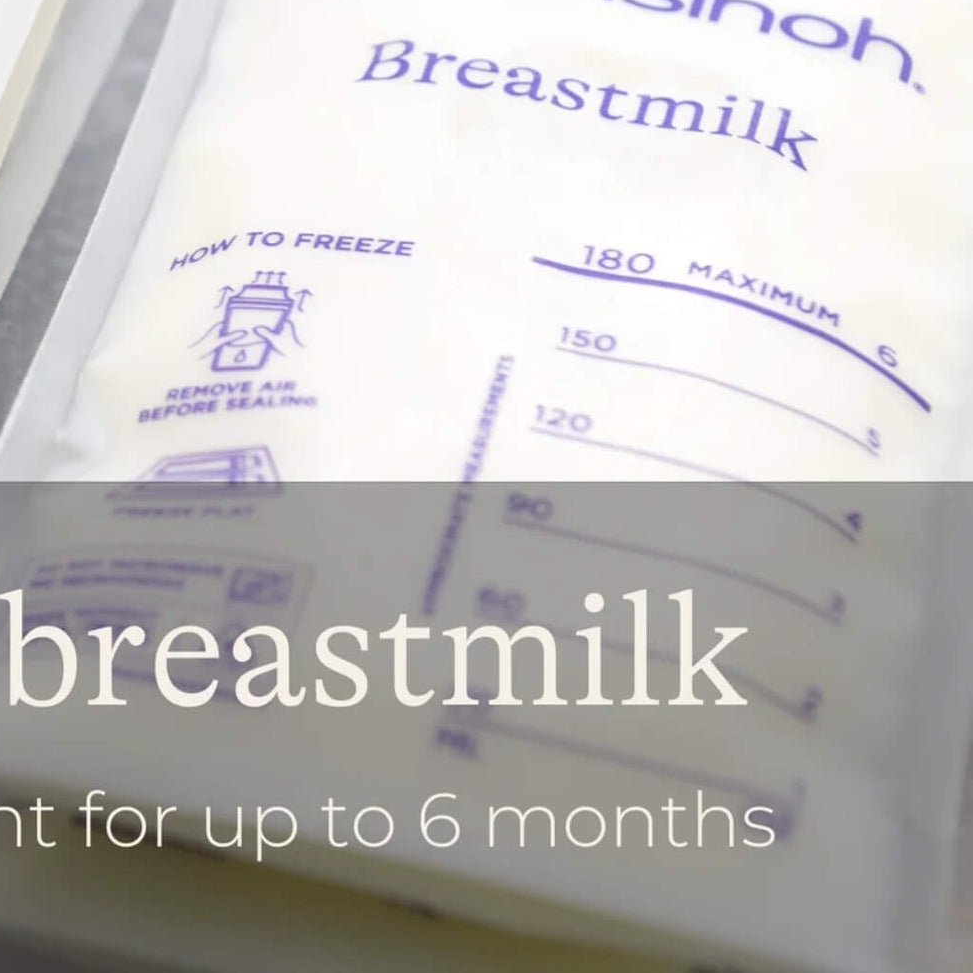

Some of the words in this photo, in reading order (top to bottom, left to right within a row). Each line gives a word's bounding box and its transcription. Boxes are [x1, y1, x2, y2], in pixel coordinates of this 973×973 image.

[354, 38, 819, 171] Breastmilk
[168, 235, 240, 272] HOW
[245, 231, 286, 248] TO
[293, 232, 416, 257] FREEZE
[581, 244, 657, 275] 180
[686, 259, 842, 328] MAXIMUM
[559, 325, 618, 353] 150
[877, 344, 897, 368] 6
[164, 381, 253, 402] REMOVE
[258, 380, 298, 392] AIR
[137, 398, 218, 424] BEFORE
[225, 394, 318, 412] SEALING
[532, 403, 593, 434] 120
